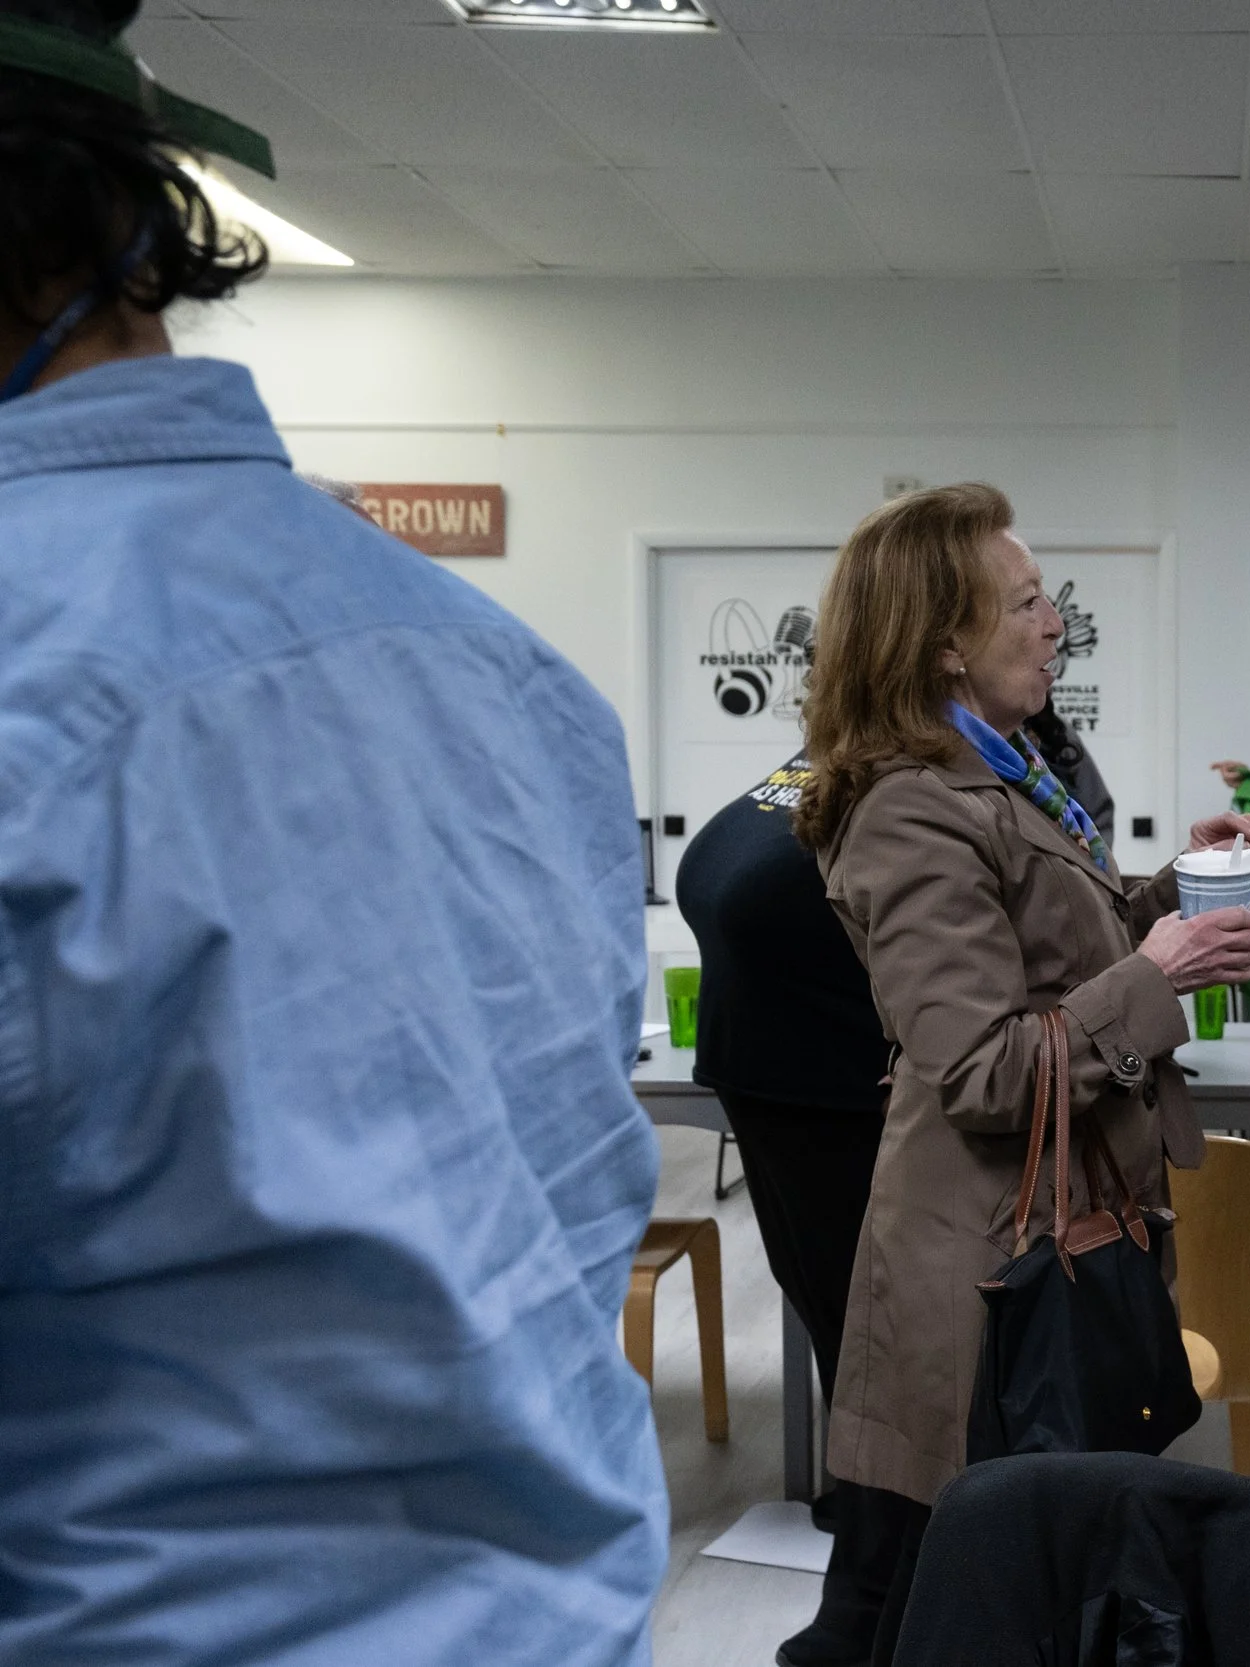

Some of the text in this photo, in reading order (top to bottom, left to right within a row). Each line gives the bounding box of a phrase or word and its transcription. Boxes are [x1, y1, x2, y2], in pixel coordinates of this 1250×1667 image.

[362, 498, 491, 535] GROWN
[700, 651, 777, 665] resistah
[1059, 705, 1098, 714] SPICE
